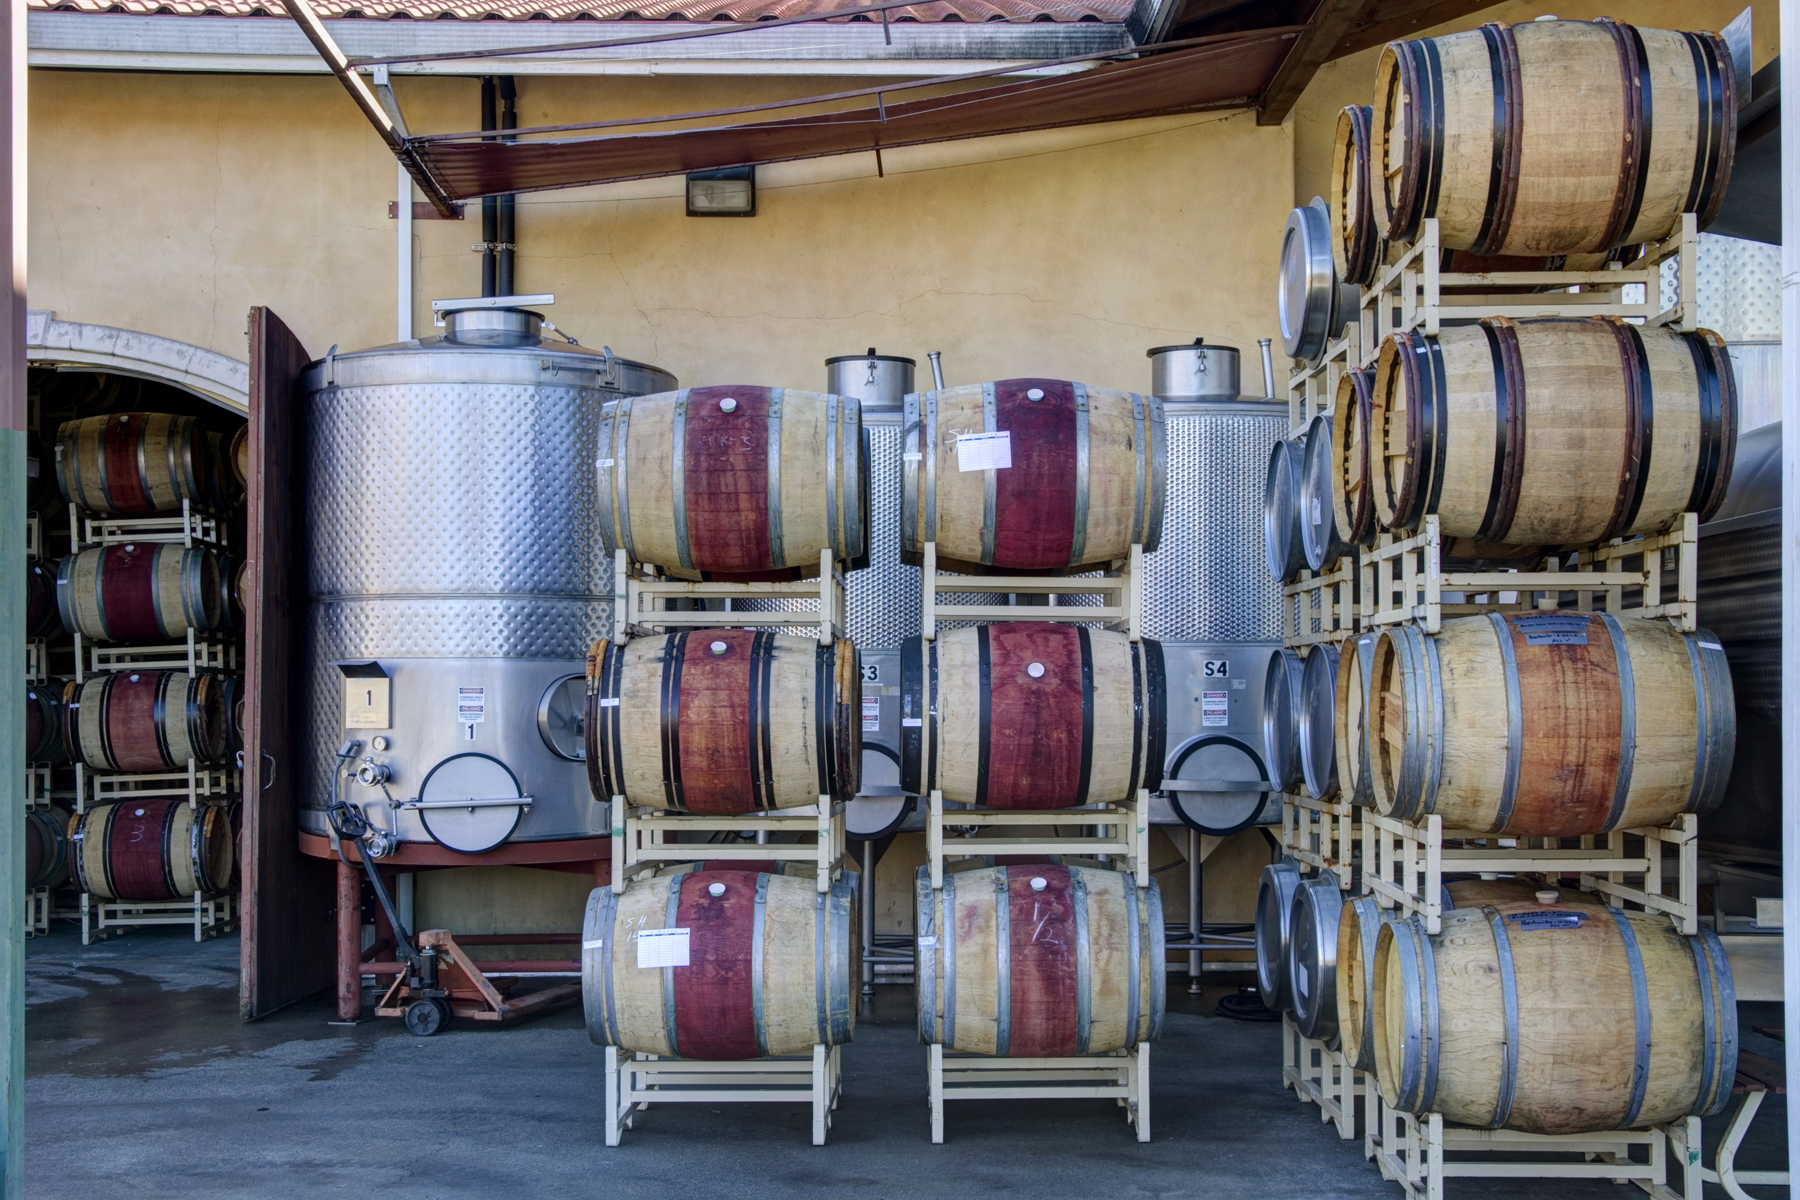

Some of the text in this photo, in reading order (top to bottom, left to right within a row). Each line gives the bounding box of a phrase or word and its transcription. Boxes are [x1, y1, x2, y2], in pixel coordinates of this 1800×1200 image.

[1204, 661, 1228, 677] S4
[366, 689, 372, 706] 1
[468, 723, 474, 740] 1
[129, 824, 145, 843] 3
